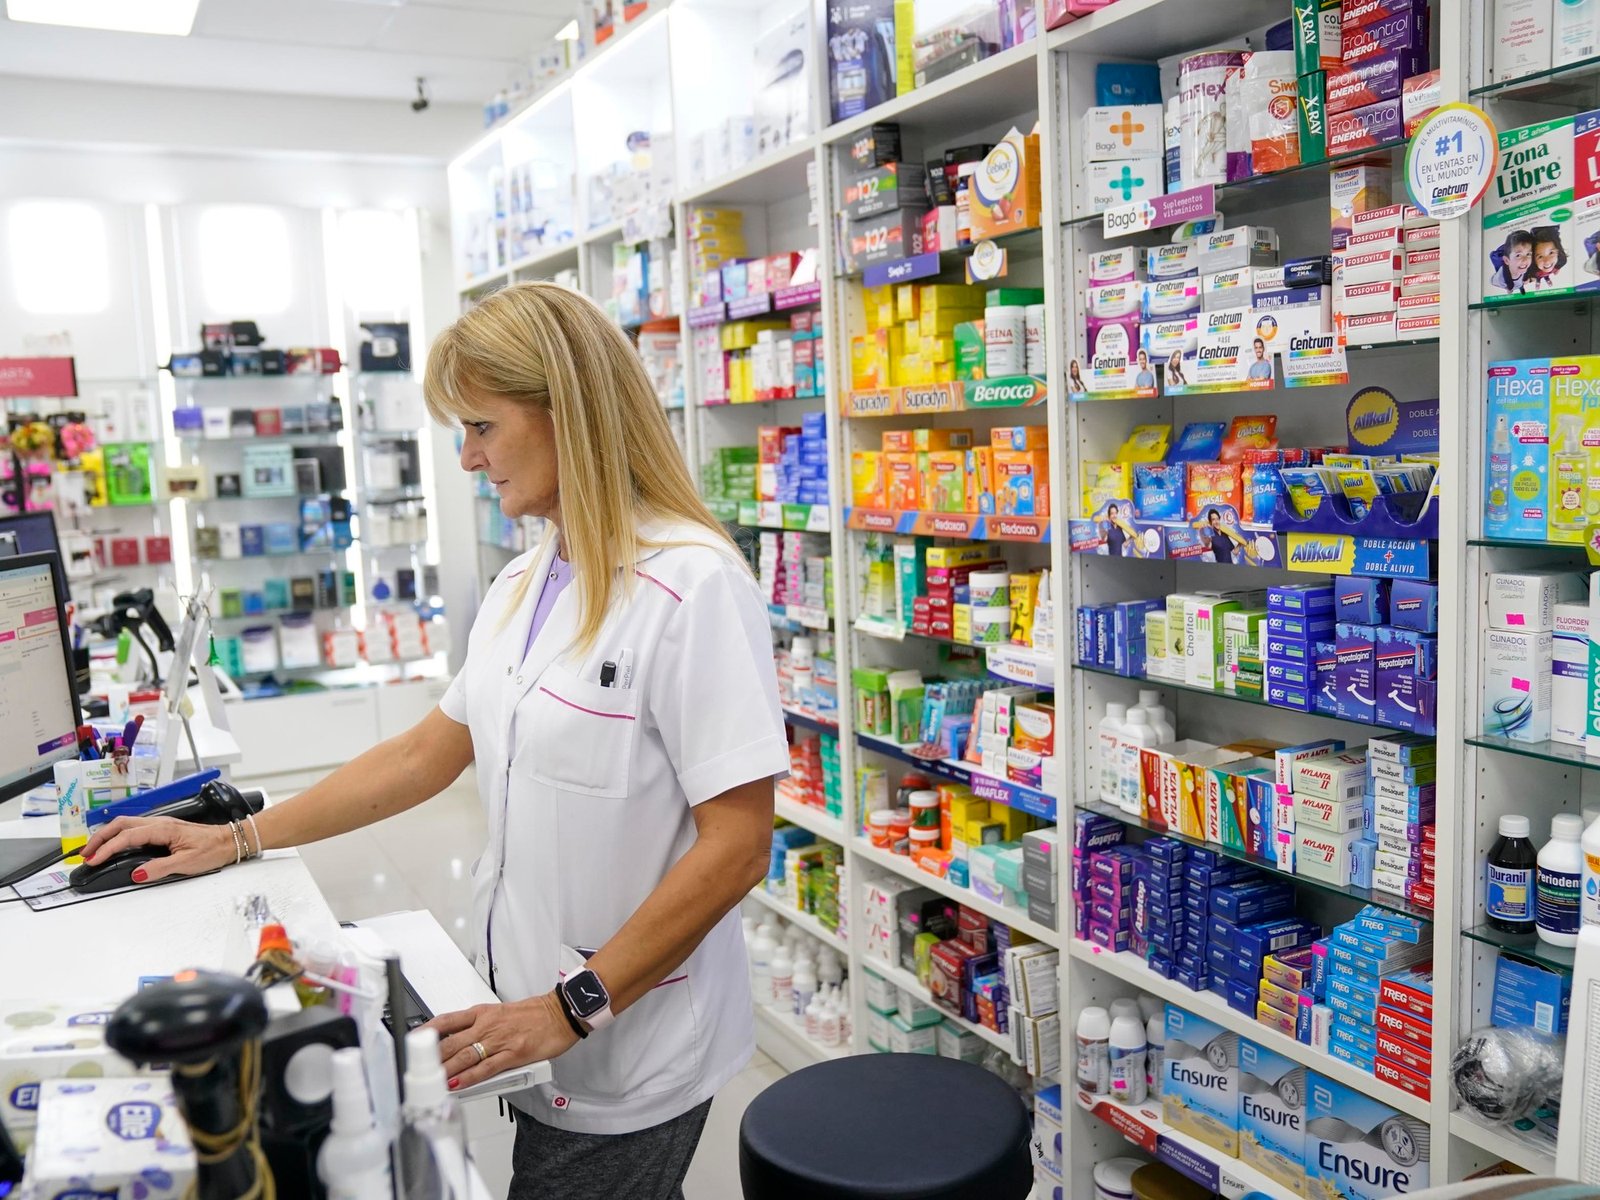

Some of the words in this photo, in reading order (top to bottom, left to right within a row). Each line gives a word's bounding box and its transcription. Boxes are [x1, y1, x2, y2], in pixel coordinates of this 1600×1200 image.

[1343, 0, 1380, 22] ENERGY
[1303, 20, 1317, 44] RAY
[1342, 15, 1408, 50] Framintrol
[1343, 41, 1379, 60] ENERGY
[1328, 56, 1397, 90] Framintrol
[1329, 80, 1367, 100] ENERGY
[1308, 111, 1322, 135] RAY
[1330, 106, 1398, 135] Framintrol
[1588, 117, 1597, 128] 2
[1331, 127, 1370, 145] ENERGY
[1435, 130, 1462, 156] #1
[1502, 136, 1508, 147] 2
[1518, 129, 1529, 140] 12
[1531, 125, 1550, 136] años
[1422, 164, 1432, 174] EN
[1434, 158, 1464, 172] VENTAS
[1468, 153, 1479, 163] EN
[1502, 143, 1549, 170] Zona
[1334, 168, 1360, 180] Pharmaton
[1426, 174, 1436, 184] EL
[1496, 161, 1562, 198] Libre
[1334, 179, 1359, 190] Essential
[1432, 182, 1469, 198] Centrum
[1162, 194, 1203, 210] Suplementos
[1107, 206, 1136, 230] Bagó
[1163, 204, 1203, 218] vitamínicos
[1357, 208, 1395, 222] FOSFOVITA
[865, 228, 888, 252] 102
[1209, 232, 1235, 246] Centrum
[1352, 230, 1390, 244] FOSFOVITA
[1100, 252, 1122, 262] Centrum
[1159, 245, 1188, 257] Centrum
[1348, 254, 1385, 266] FOSFOVITA
[1214, 272, 1239, 284] Centrum
[1100, 288, 1126, 298] Centrum
[1156, 282, 1185, 292] Centrum
[1348, 285, 1386, 296] FOSFOVITA
[1256, 295, 1281, 307] BIOZINC
[1283, 294, 1288, 304] D
[1400, 296, 1433, 306] FOSFOVITA
[1208, 312, 1243, 327] Centrum
[1350, 315, 1388, 326] FOSFOVITA
[1400, 320, 1432, 328] FOSFOVITA
[1101, 332, 1122, 340] Centrum
[1156, 324, 1186, 334] Centrum
[1290, 336, 1333, 350] Centrum
[1199, 346, 1240, 360] Centrum
[1094, 357, 1126, 370] Centrum
[974, 384, 1034, 402] Berocca
[1496, 378, 1544, 396] Hexa
[853, 396, 890, 411] Supradyn
[906, 388, 948, 408] Supradyn
[1354, 408, 1393, 432] Alikal
[1410, 409, 1434, 418] DOBLE
[1188, 430, 1214, 441] UVASAL
[1237, 425, 1265, 438] UVASAL
[1412, 428, 1437, 438] DOBLE
[1344, 477, 1363, 488] Alikal
[1142, 494, 1168, 504] UVASAL
[1197, 494, 1224, 506] UVASAL
[1169, 532, 1190, 542] UVASAL
[1291, 538, 1344, 562] Alikal
[1364, 540, 1386, 548] DOBLE
[1388, 540, 1415, 550] ACCIÓN
[1365, 562, 1388, 572] DOBLE
[1390, 563, 1414, 573] ALIVIO
[1496, 578, 1526, 587] CLINADOL
[1490, 634, 1527, 646] CLINADOL
[1338, 652, 1370, 664] Hepatalgina
[1379, 657, 1414, 669] Hepatalgina
[1016, 664, 1034, 677] horas
[1300, 768, 1331, 780] MYLANTA
[1320, 780, 1330, 790] II
[974, 786, 1008, 801] ANAFLEX
[1169, 772, 1178, 827] MYLANTA
[1208, 781, 1218, 838] MYLANTA
[1302, 799, 1332, 812] MYLANTA
[1323, 811, 1332, 821] II
[1088, 831, 1122, 847] Aziatop
[1303, 838, 1335, 853] MYLANTA
[1324, 852, 1334, 862] II
[1490, 867, 1526, 884] Duranil
[1135, 880, 1146, 932] Aziatop
[1361, 920, 1384, 931] TREG
[1340, 933, 1358, 946] TREG
[1334, 948, 1352, 960] TREG
[1335, 963, 1353, 976] TREG
[1332, 980, 1350, 993] TREG
[1384, 987, 1407, 1002] TREG
[1330, 996, 1348, 1010] TREG
[1338, 1013, 1356, 1026] TREG
[1380, 1012, 1402, 1030] TREG
[1336, 1029, 1354, 1042] TREG
[1334, 1045, 1350, 1058] TREG
[1379, 1039, 1402, 1056] TREG
[1172, 1062, 1228, 1091] Ensure
[1376, 1063, 1398, 1080] TREG
[1243, 1096, 1300, 1131] Ensure
[1319, 1142, 1409, 1194] Ensure
[1223, 1176, 1244, 1190] Ensure
